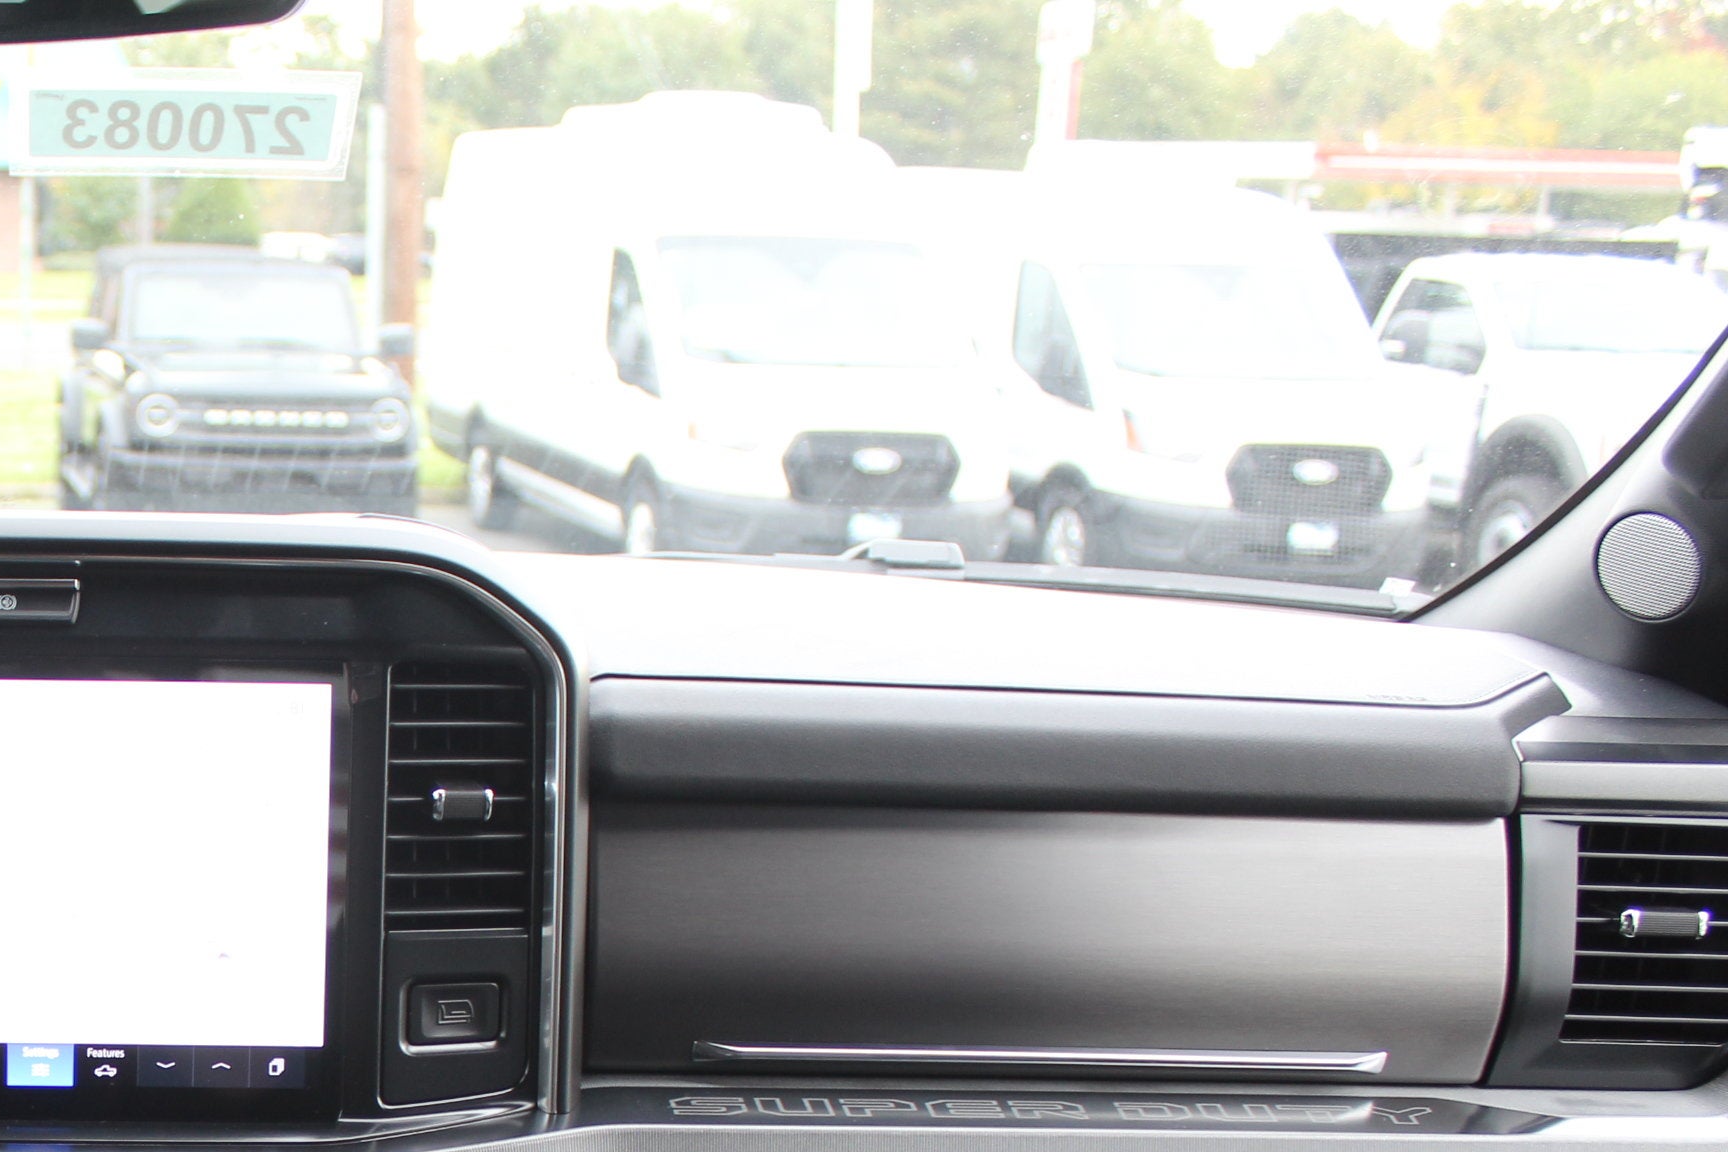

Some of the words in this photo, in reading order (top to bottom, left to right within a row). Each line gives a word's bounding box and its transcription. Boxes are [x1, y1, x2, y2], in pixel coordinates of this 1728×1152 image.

[86, 1047, 125, 1059] Features
[670, 1096, 1090, 1120] SUPER
[1113, 1101, 1433, 1125] DUTY
